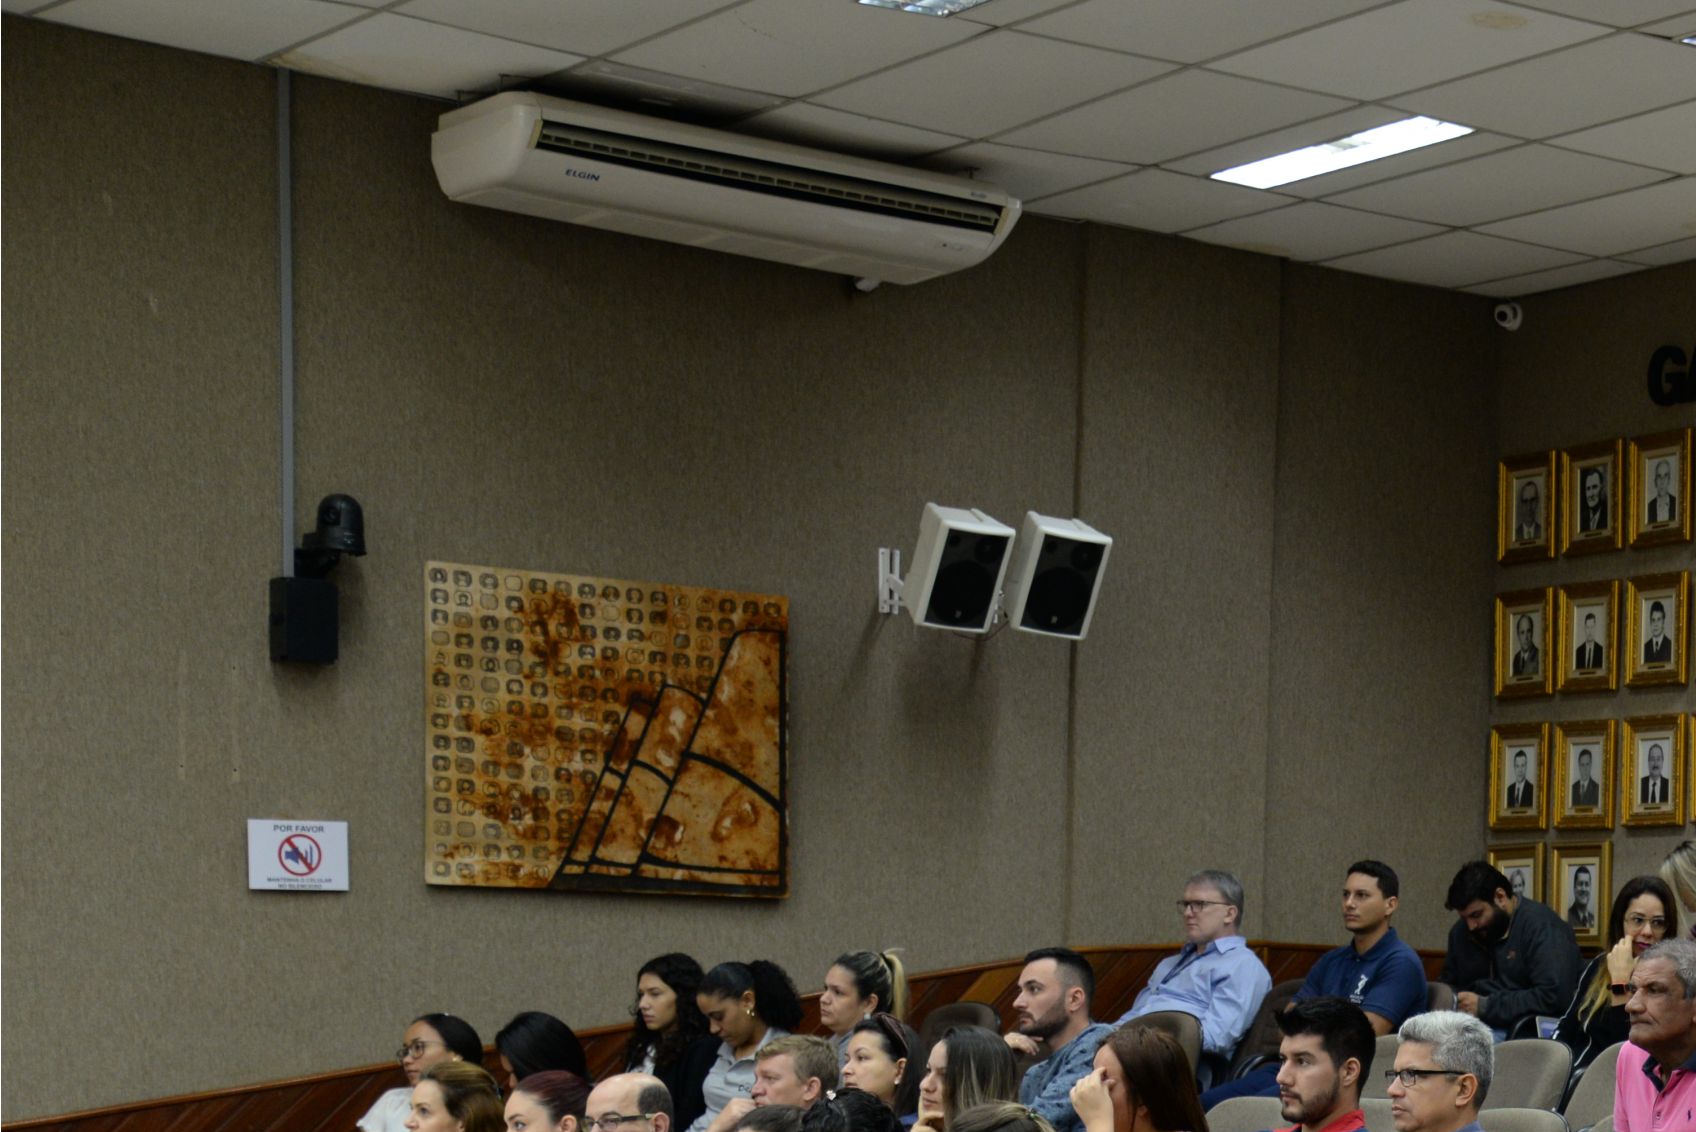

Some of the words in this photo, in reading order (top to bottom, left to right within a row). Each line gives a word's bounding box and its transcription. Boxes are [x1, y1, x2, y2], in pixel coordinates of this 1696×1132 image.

[565, 168, 600, 181] ELGIN
[273, 824, 293, 832] POR
[295, 825, 325, 833] FAVOR
